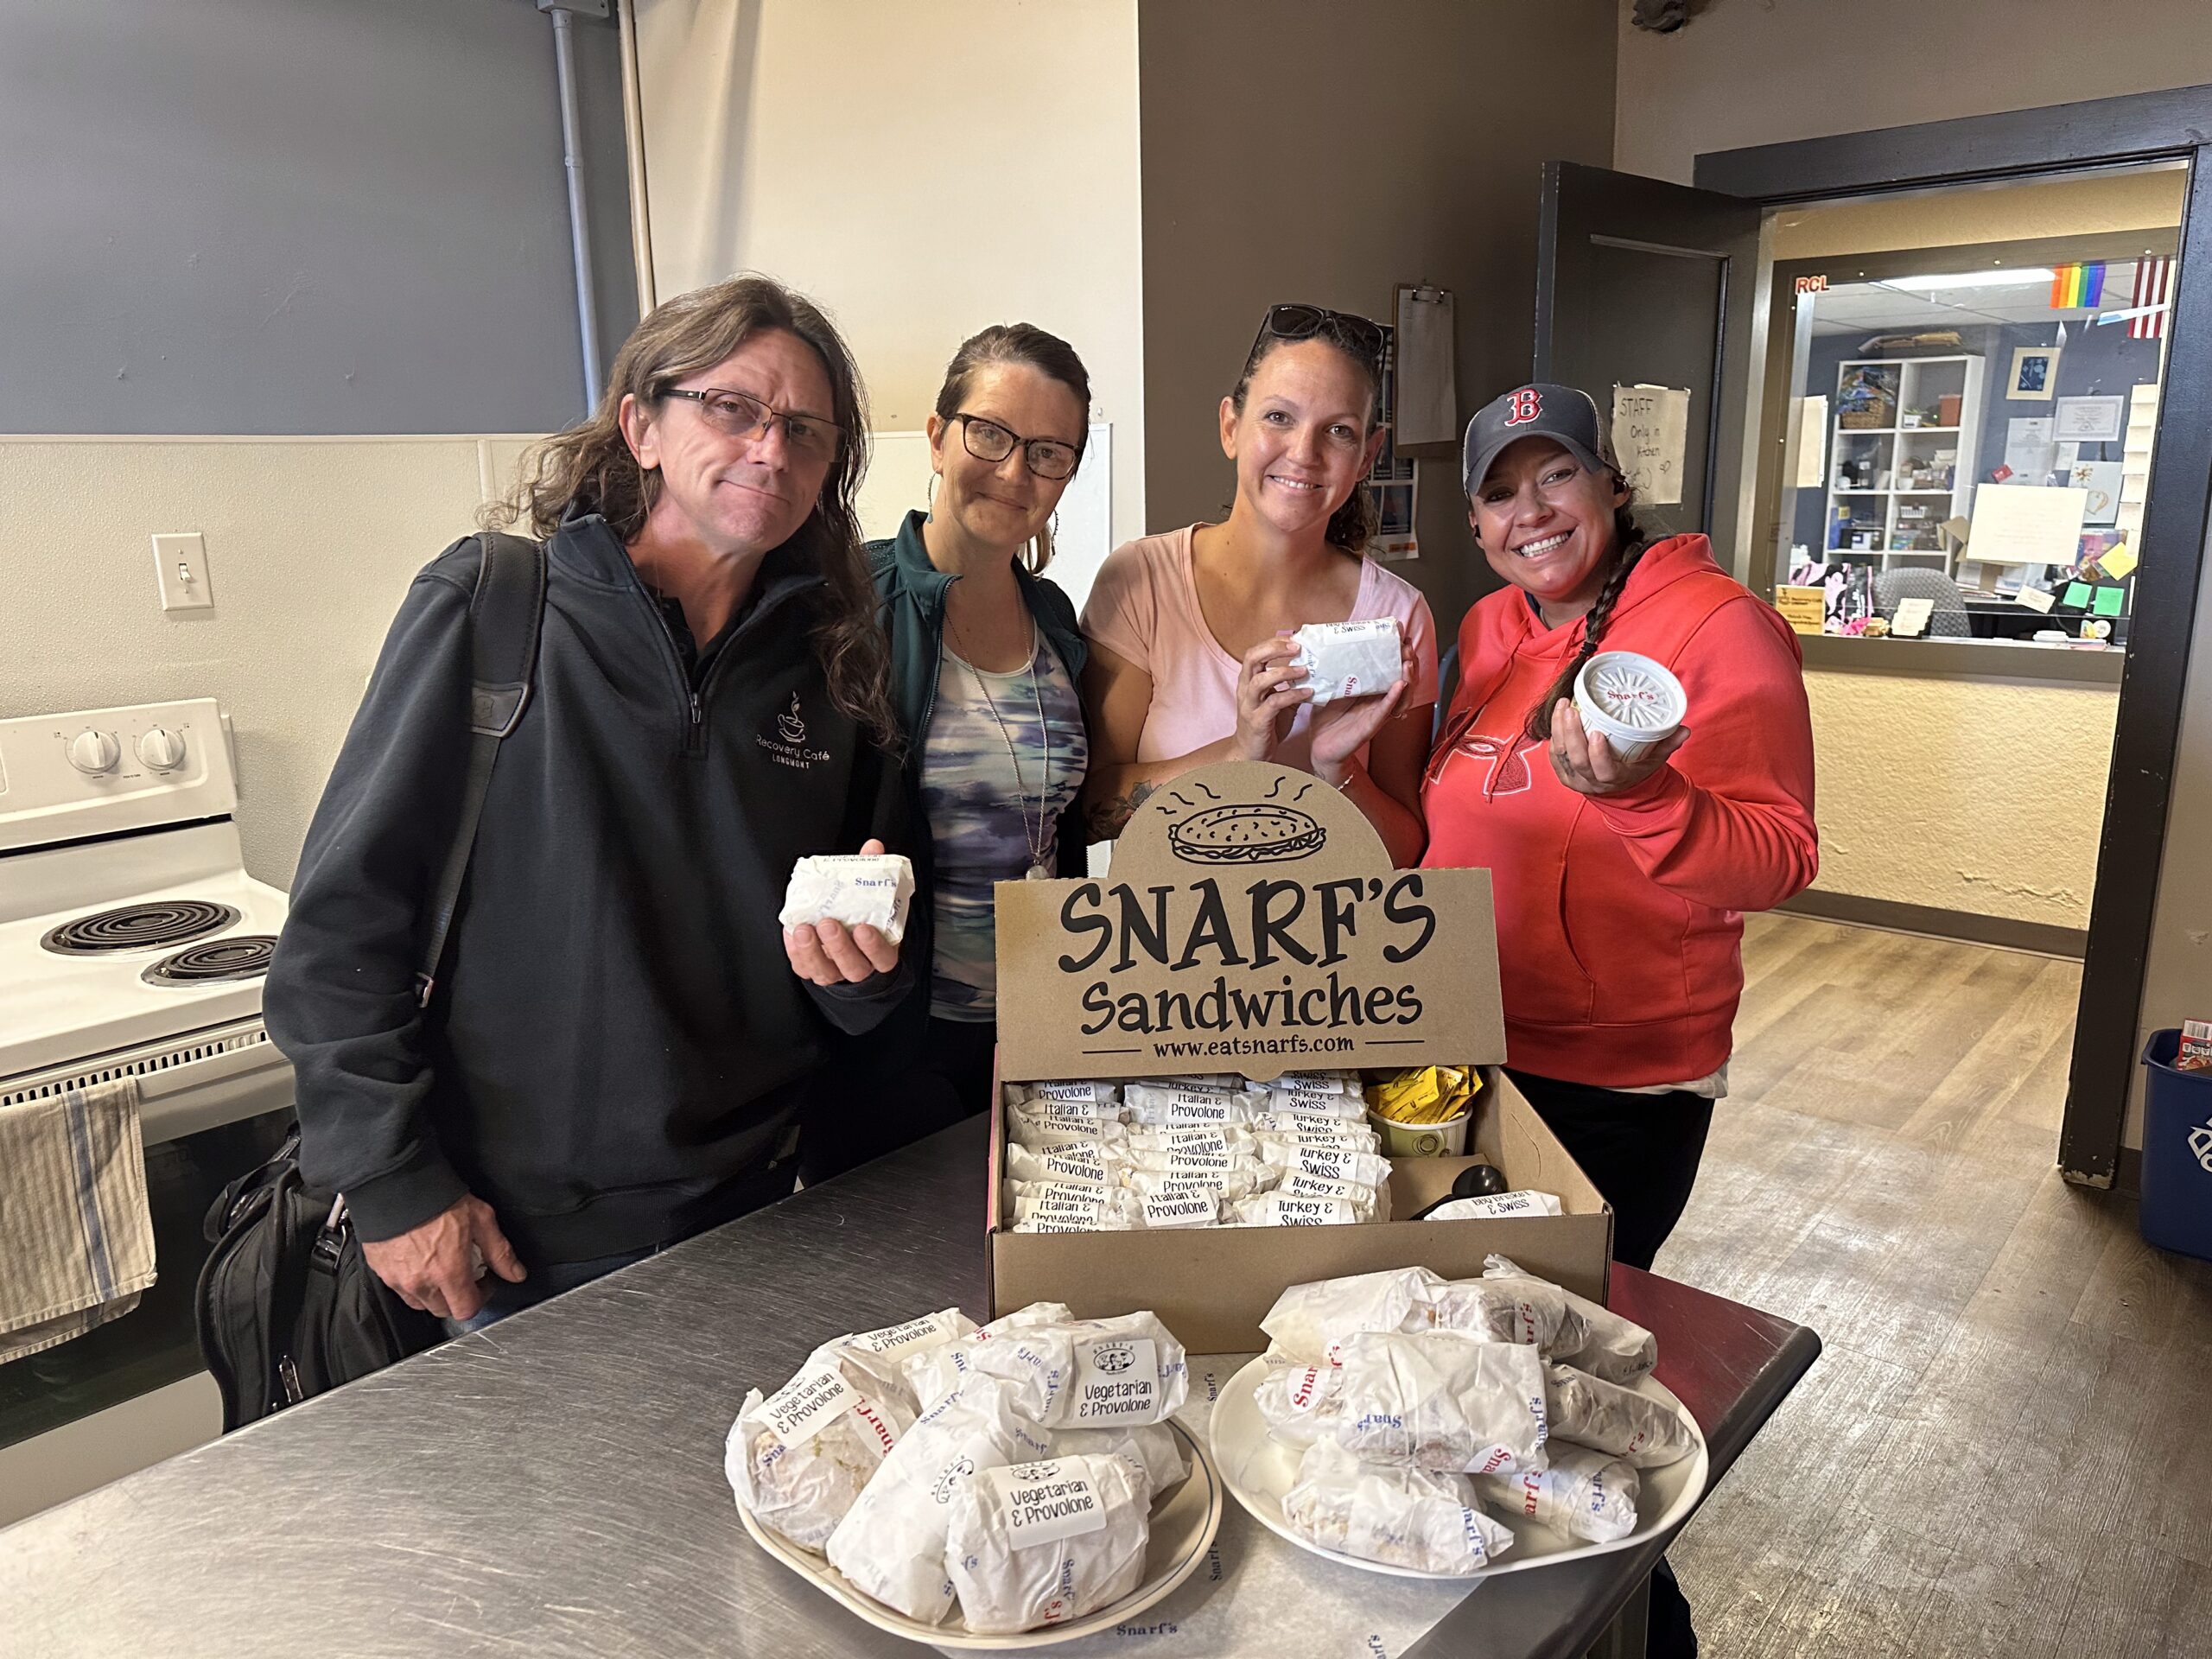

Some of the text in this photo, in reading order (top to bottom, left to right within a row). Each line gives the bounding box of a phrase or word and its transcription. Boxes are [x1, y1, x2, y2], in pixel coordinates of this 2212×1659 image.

[1795, 275, 1830, 296] RCL
[1504, 388, 1543, 427] B
[1619, 397, 1654, 417] STAFF
[756, 734, 830, 761] Recovery Café
[772, 753, 810, 769] LONGMONT
[854, 876, 898, 888] Snarf's
[1058, 873, 1437, 975] SNARF'S
[1080, 971, 1424, 1036] Sandwiches
[1153, 1034, 1355, 1059] www.eatsnarfs.com
[1039, 1086, 1092, 1100] Provolone
[1294, 1080, 1330, 1090] Swiss
[1178, 1093, 1211, 1105] Italian
[1289, 1097, 1326, 1110] Swiss
[1044, 1103, 1078, 1116] Italian
[1171, 1103, 1225, 1120] Provolone
[1044, 1121, 1098, 1135] Provolone
[1293, 1114, 1330, 1127] Turkey
[1172, 1132, 1207, 1145] Italian
[1297, 1135, 1337, 1144] Turkey
[1042, 1143, 1078, 1156] Italian
[1300, 1147, 1340, 1164] Turkey
[1046, 1157, 1104, 1181] Provolone
[1170, 1154, 1228, 1168] Provolone
[1300, 1160, 1340, 1179] Swiss
[1163, 1179, 1223, 1193] Provolone
[1292, 1175, 1334, 1195] Turkey
[1039, 1200, 1079, 1212] Italian
[1149, 1192, 1190, 1204] Italian
[1498, 1198, 1530, 1214] Swiss
[1147, 1201, 1209, 1219] Provolone
[1278, 1199, 1321, 1216] Turkey
[867, 1319, 931, 1340] Vegetarian
[884, 1324, 938, 1350] Provolone
[769, 1372, 836, 1420] Vegetarian
[1084, 1379, 1153, 1402] Vegetarian
[786, 1382, 845, 1427] Provolone
[1091, 1397, 1152, 1416] Provolone
[1009, 1479, 1089, 1507] Vegetarian
[1025, 1495, 1094, 1525] Provolone
[1116, 1622, 1179, 1637] Snarf's
